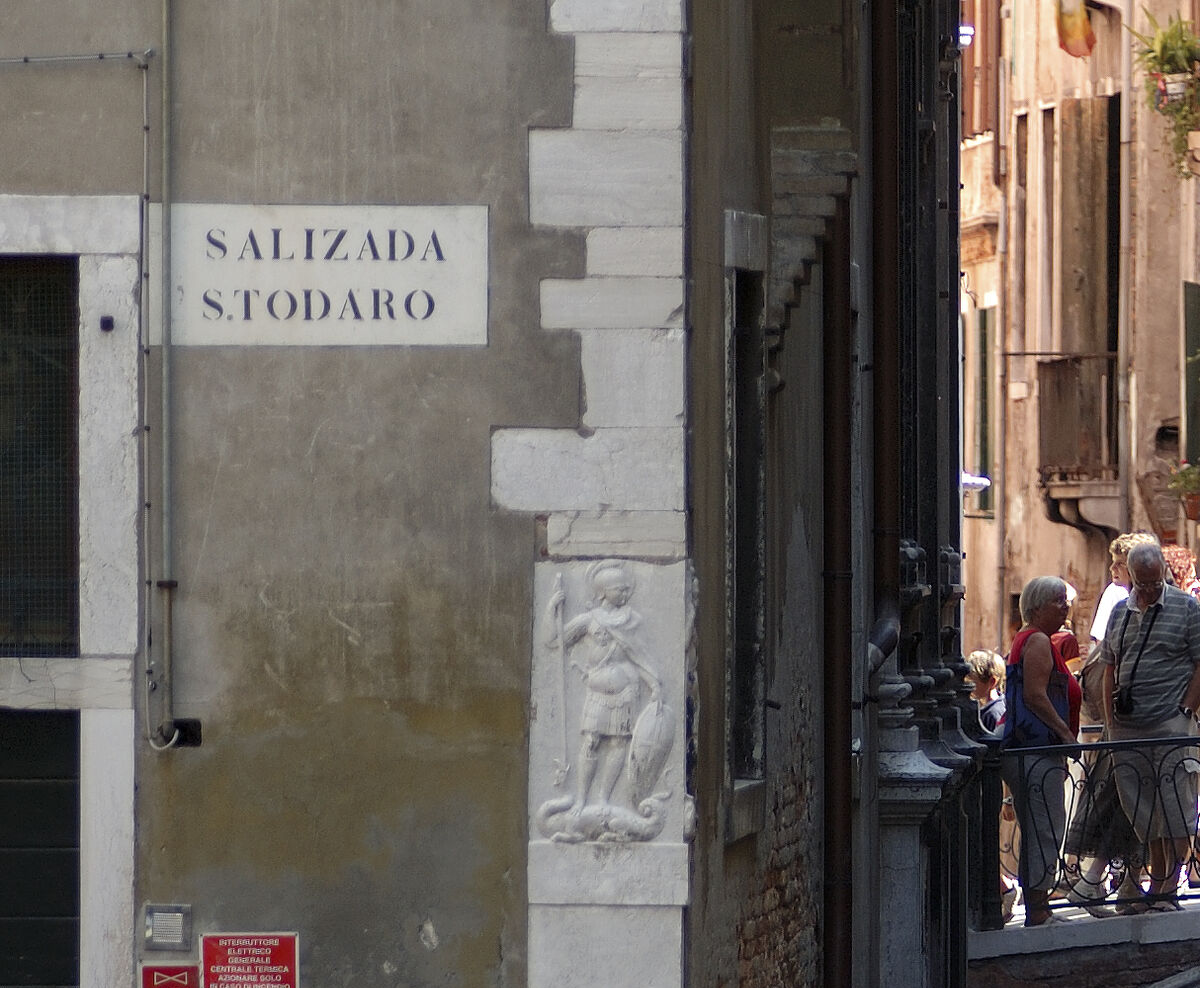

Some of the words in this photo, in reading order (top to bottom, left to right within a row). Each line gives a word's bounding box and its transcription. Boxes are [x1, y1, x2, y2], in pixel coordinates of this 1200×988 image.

[205, 228, 446, 261] SALIZADA
[201, 288, 436, 321] S.TODARO
[210, 965, 252, 973] CENTRALE
